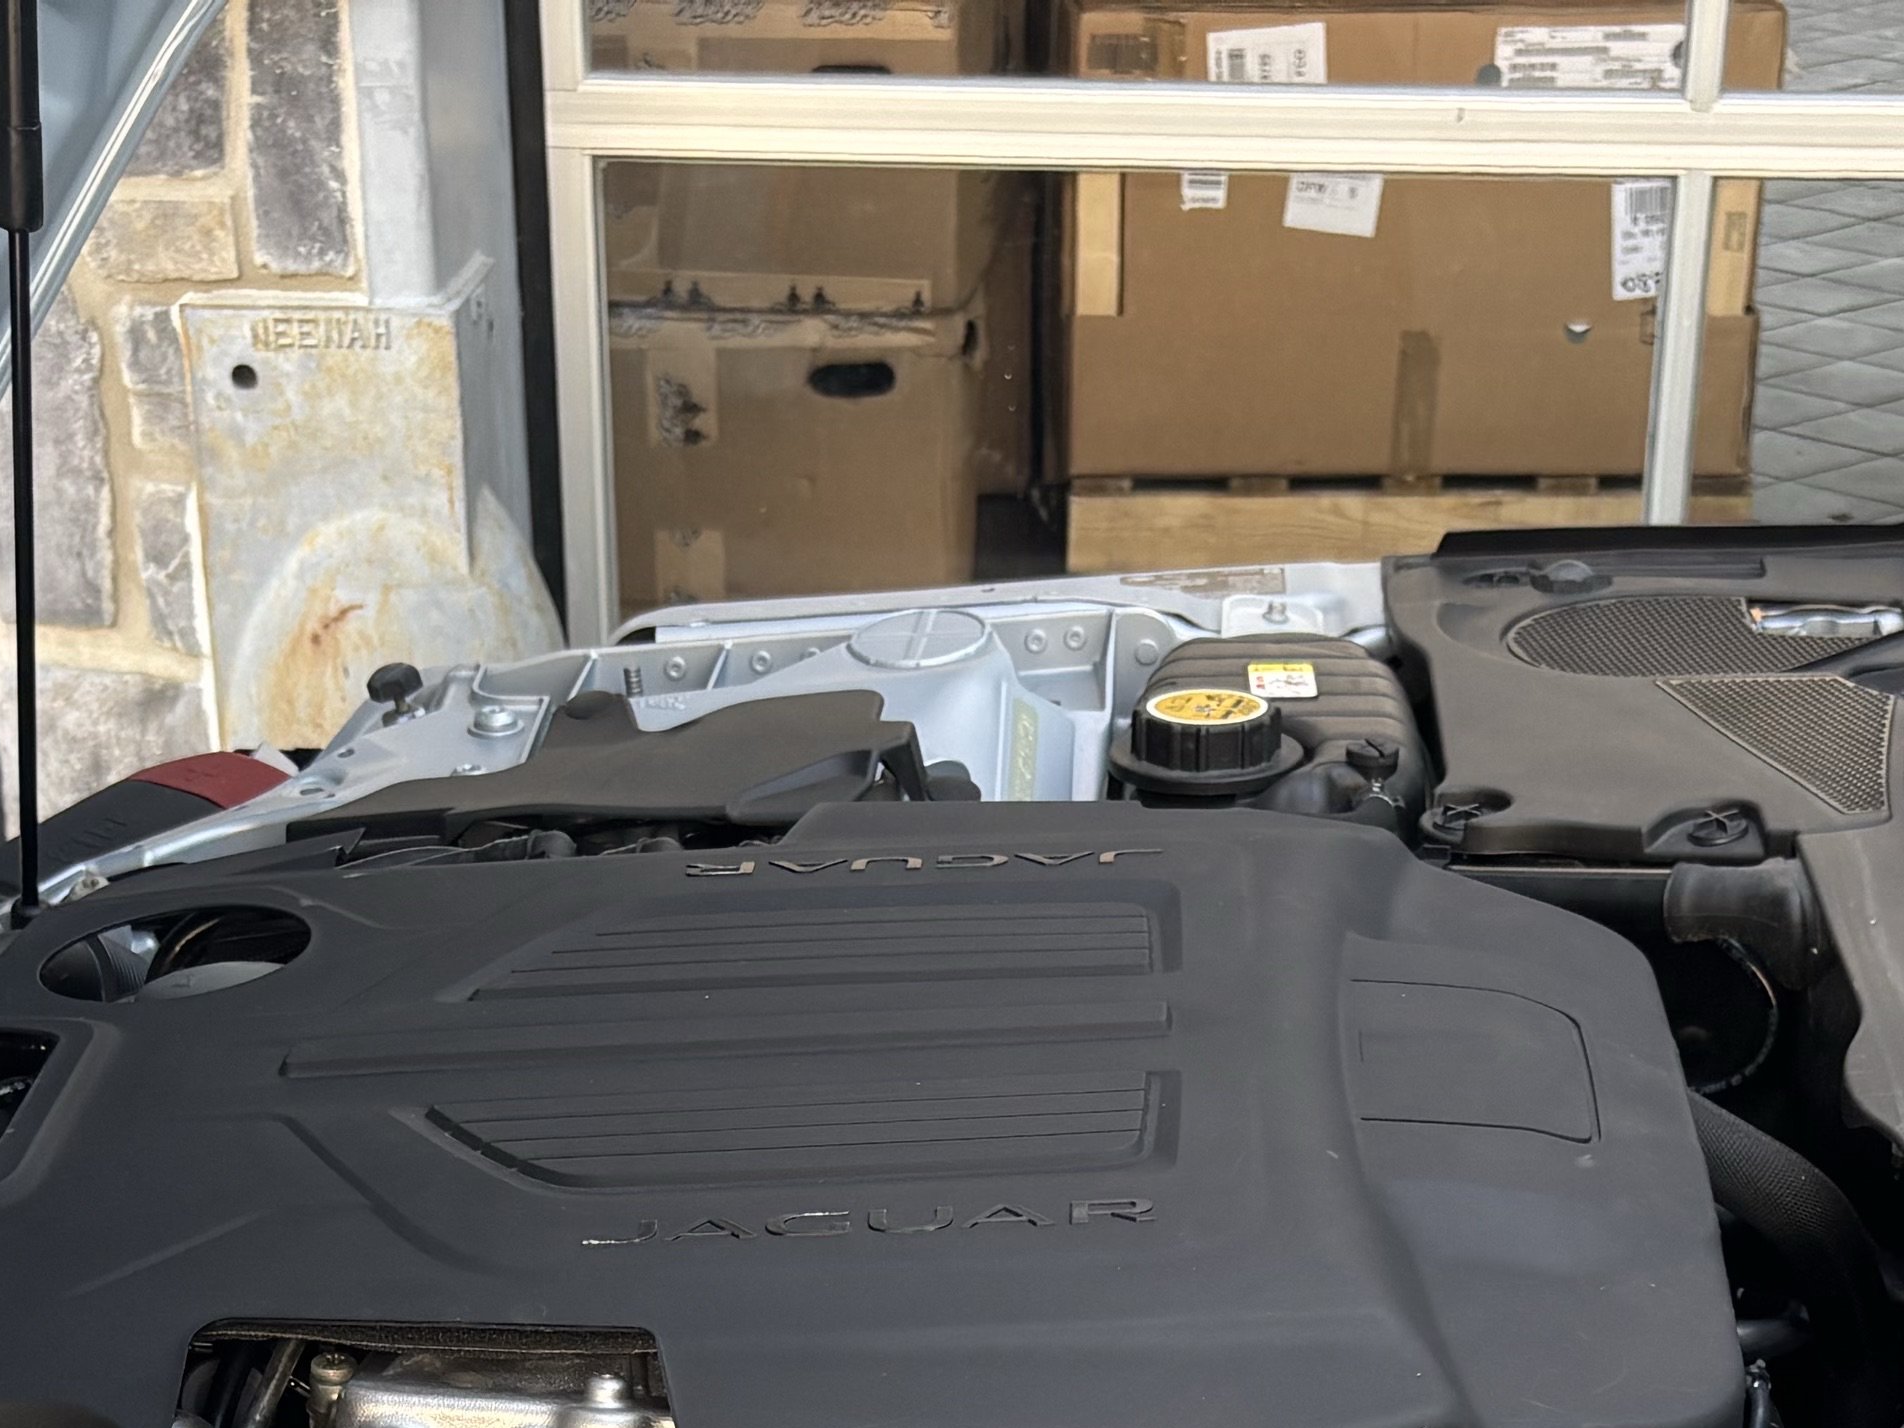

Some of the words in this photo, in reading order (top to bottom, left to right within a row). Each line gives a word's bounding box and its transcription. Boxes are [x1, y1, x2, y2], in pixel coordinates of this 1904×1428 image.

[250, 316, 393, 353] NEENAH
[684, 847, 1165, 878] JAGUAR
[580, 1197, 1158, 1247] JAGUAR
